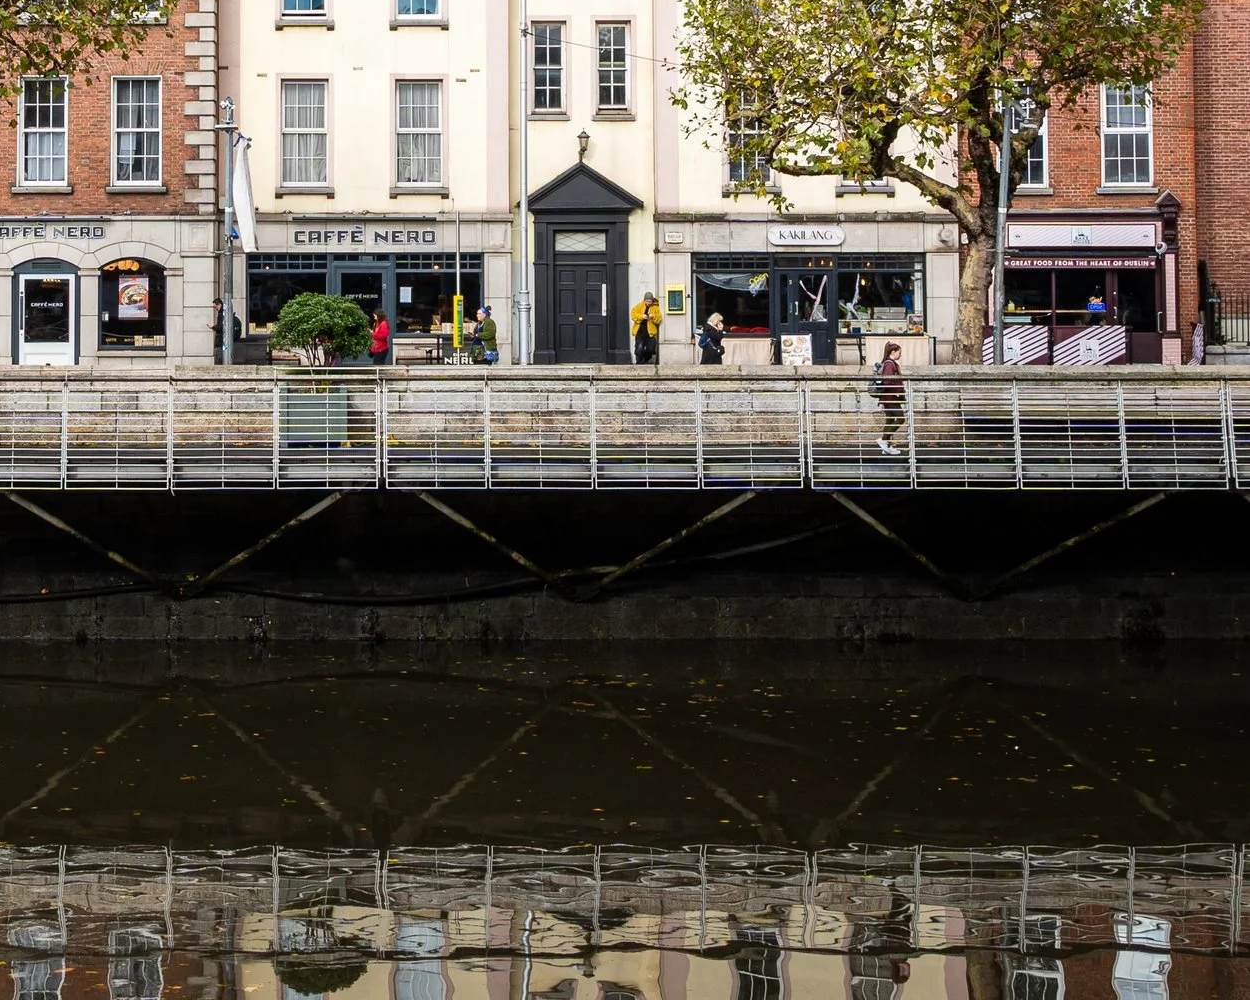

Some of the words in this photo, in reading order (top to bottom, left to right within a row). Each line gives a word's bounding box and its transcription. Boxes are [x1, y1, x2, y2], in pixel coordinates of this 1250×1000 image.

[53, 226, 105, 239] NERO
[294, 225, 364, 244] CAFFÈ
[374, 230, 436, 244] NERO
[779, 230, 833, 240] KAKILANG
